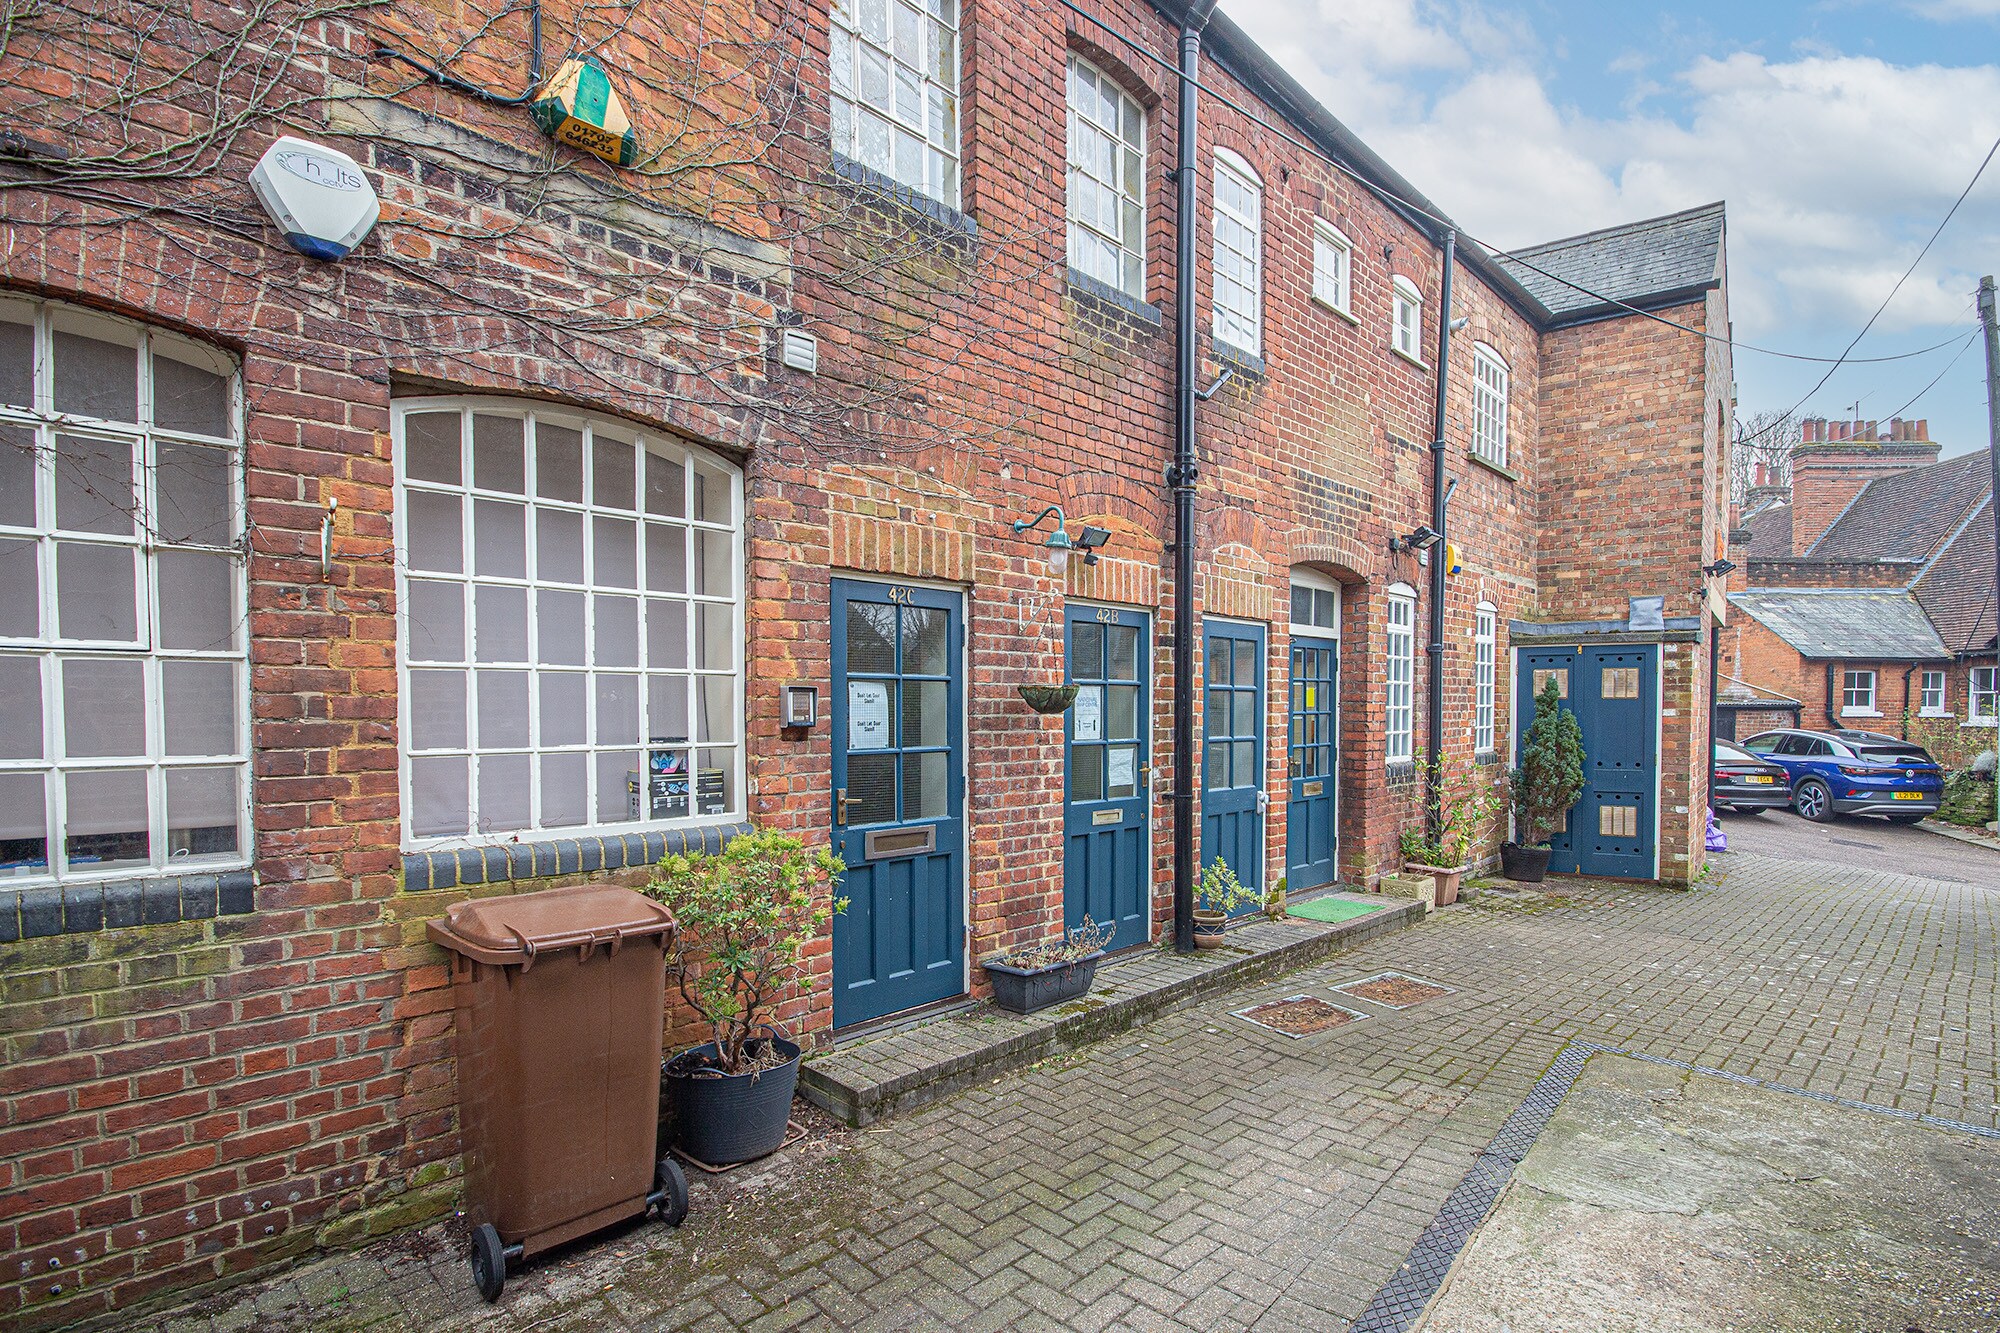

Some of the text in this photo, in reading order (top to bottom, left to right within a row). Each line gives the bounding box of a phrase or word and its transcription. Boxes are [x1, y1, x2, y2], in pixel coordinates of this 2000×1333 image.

[572, 123, 614, 144] 01707
[888, 585, 915, 605] 42C
[1096, 608, 1119, 624] 42B
